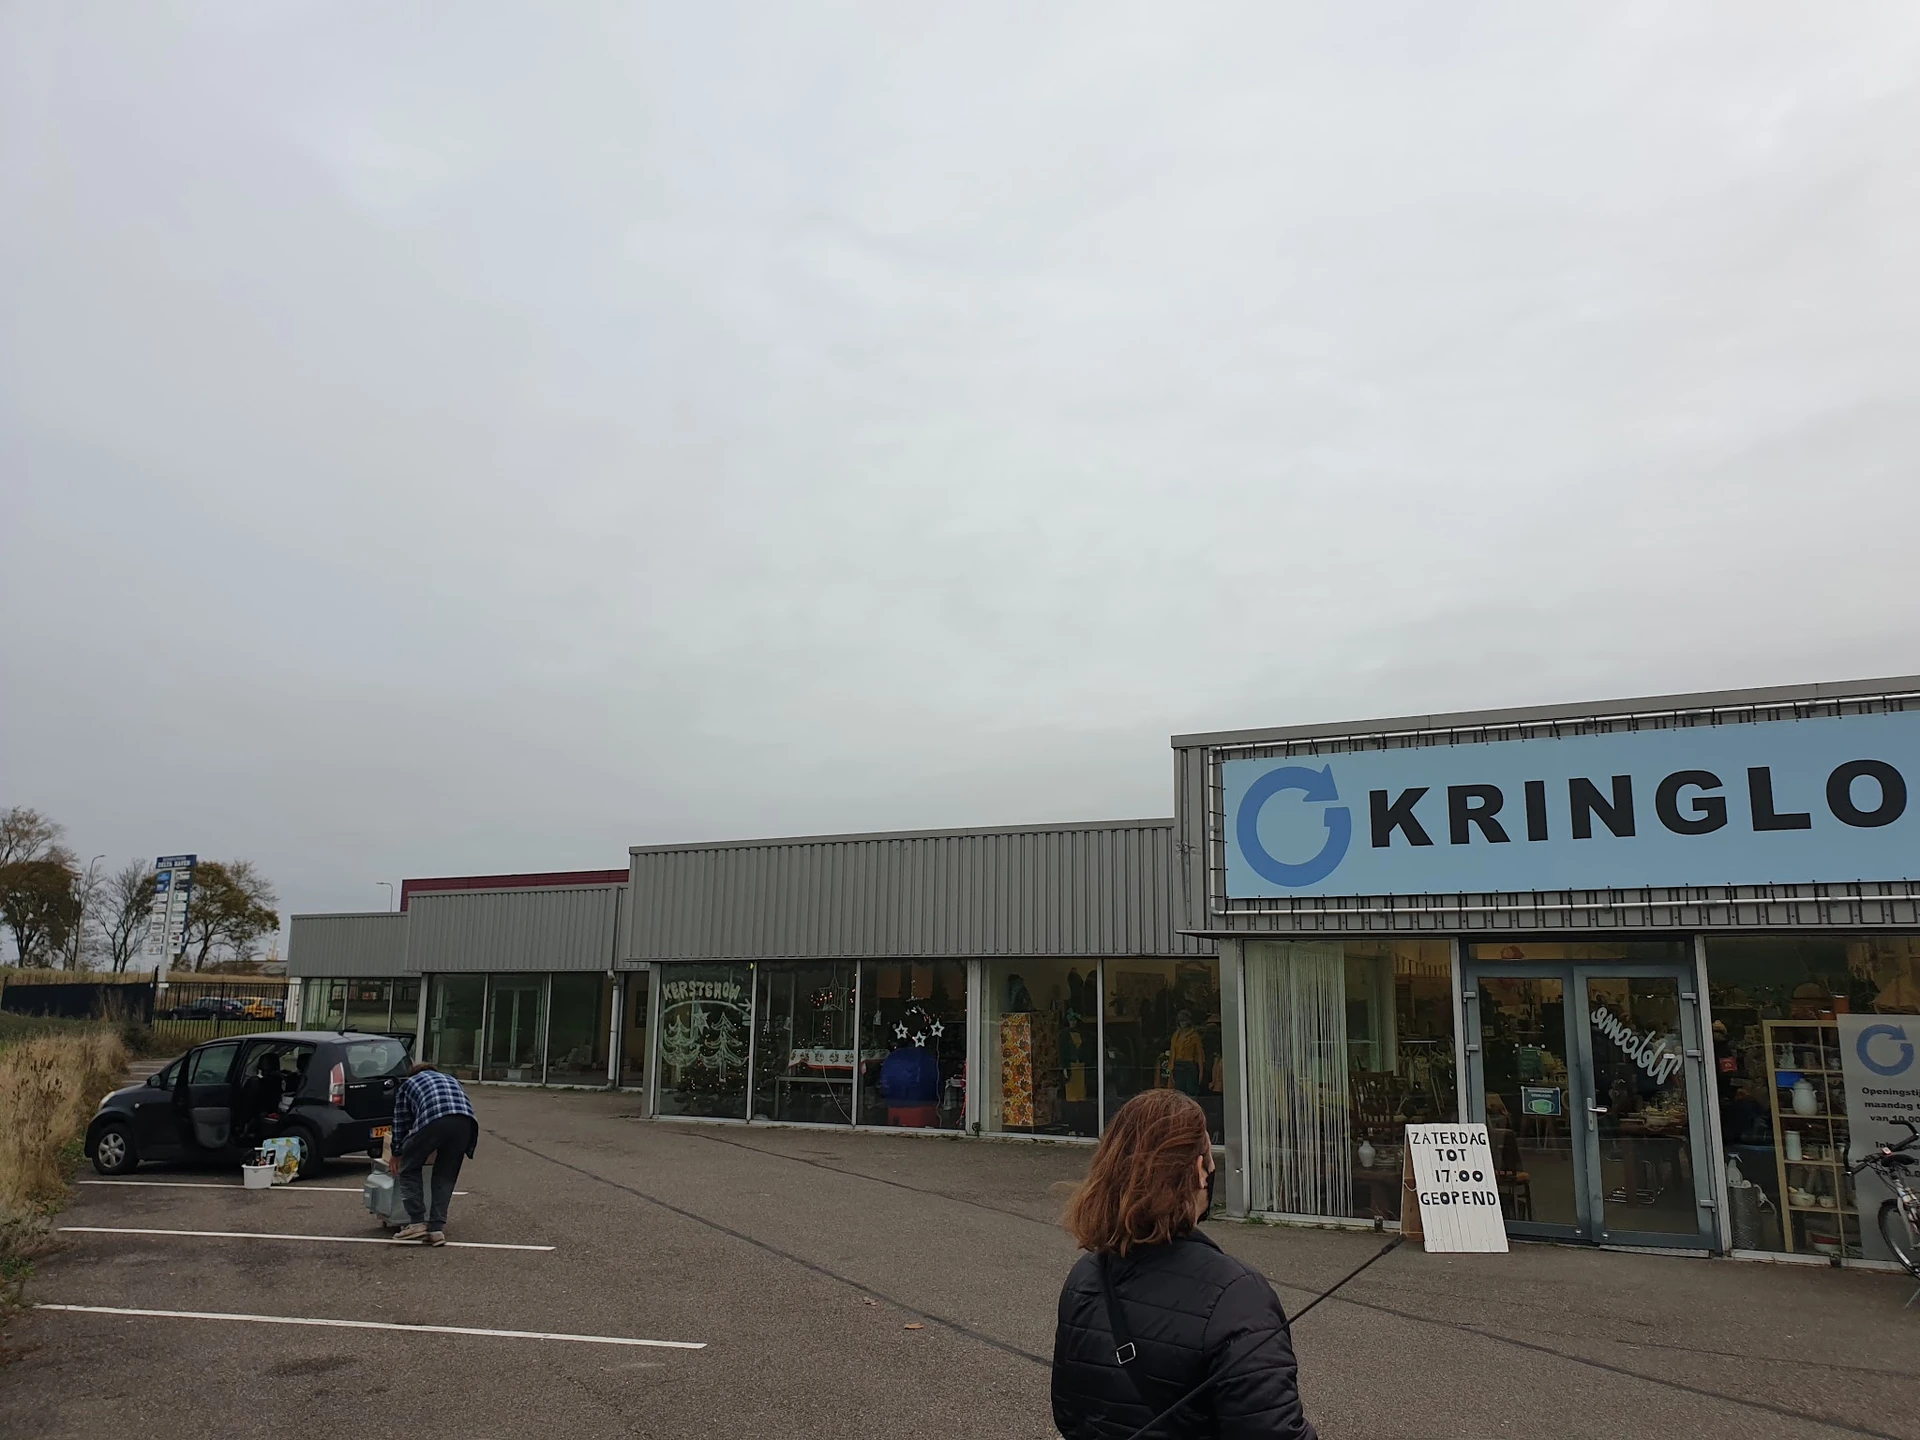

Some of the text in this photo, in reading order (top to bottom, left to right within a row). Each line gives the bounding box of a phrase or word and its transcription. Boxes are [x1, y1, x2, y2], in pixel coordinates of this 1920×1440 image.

[1368, 759, 1908, 848] KRINGLO
[1865, 1102, 1913, 1111] maandag
[1411, 1131, 1486, 1145] ZATERDAG
[1435, 1149, 1467, 1162] TOT
[1435, 1169, 1484, 1183] 17:00
[1420, 1191, 1496, 1206] GEOPEND
